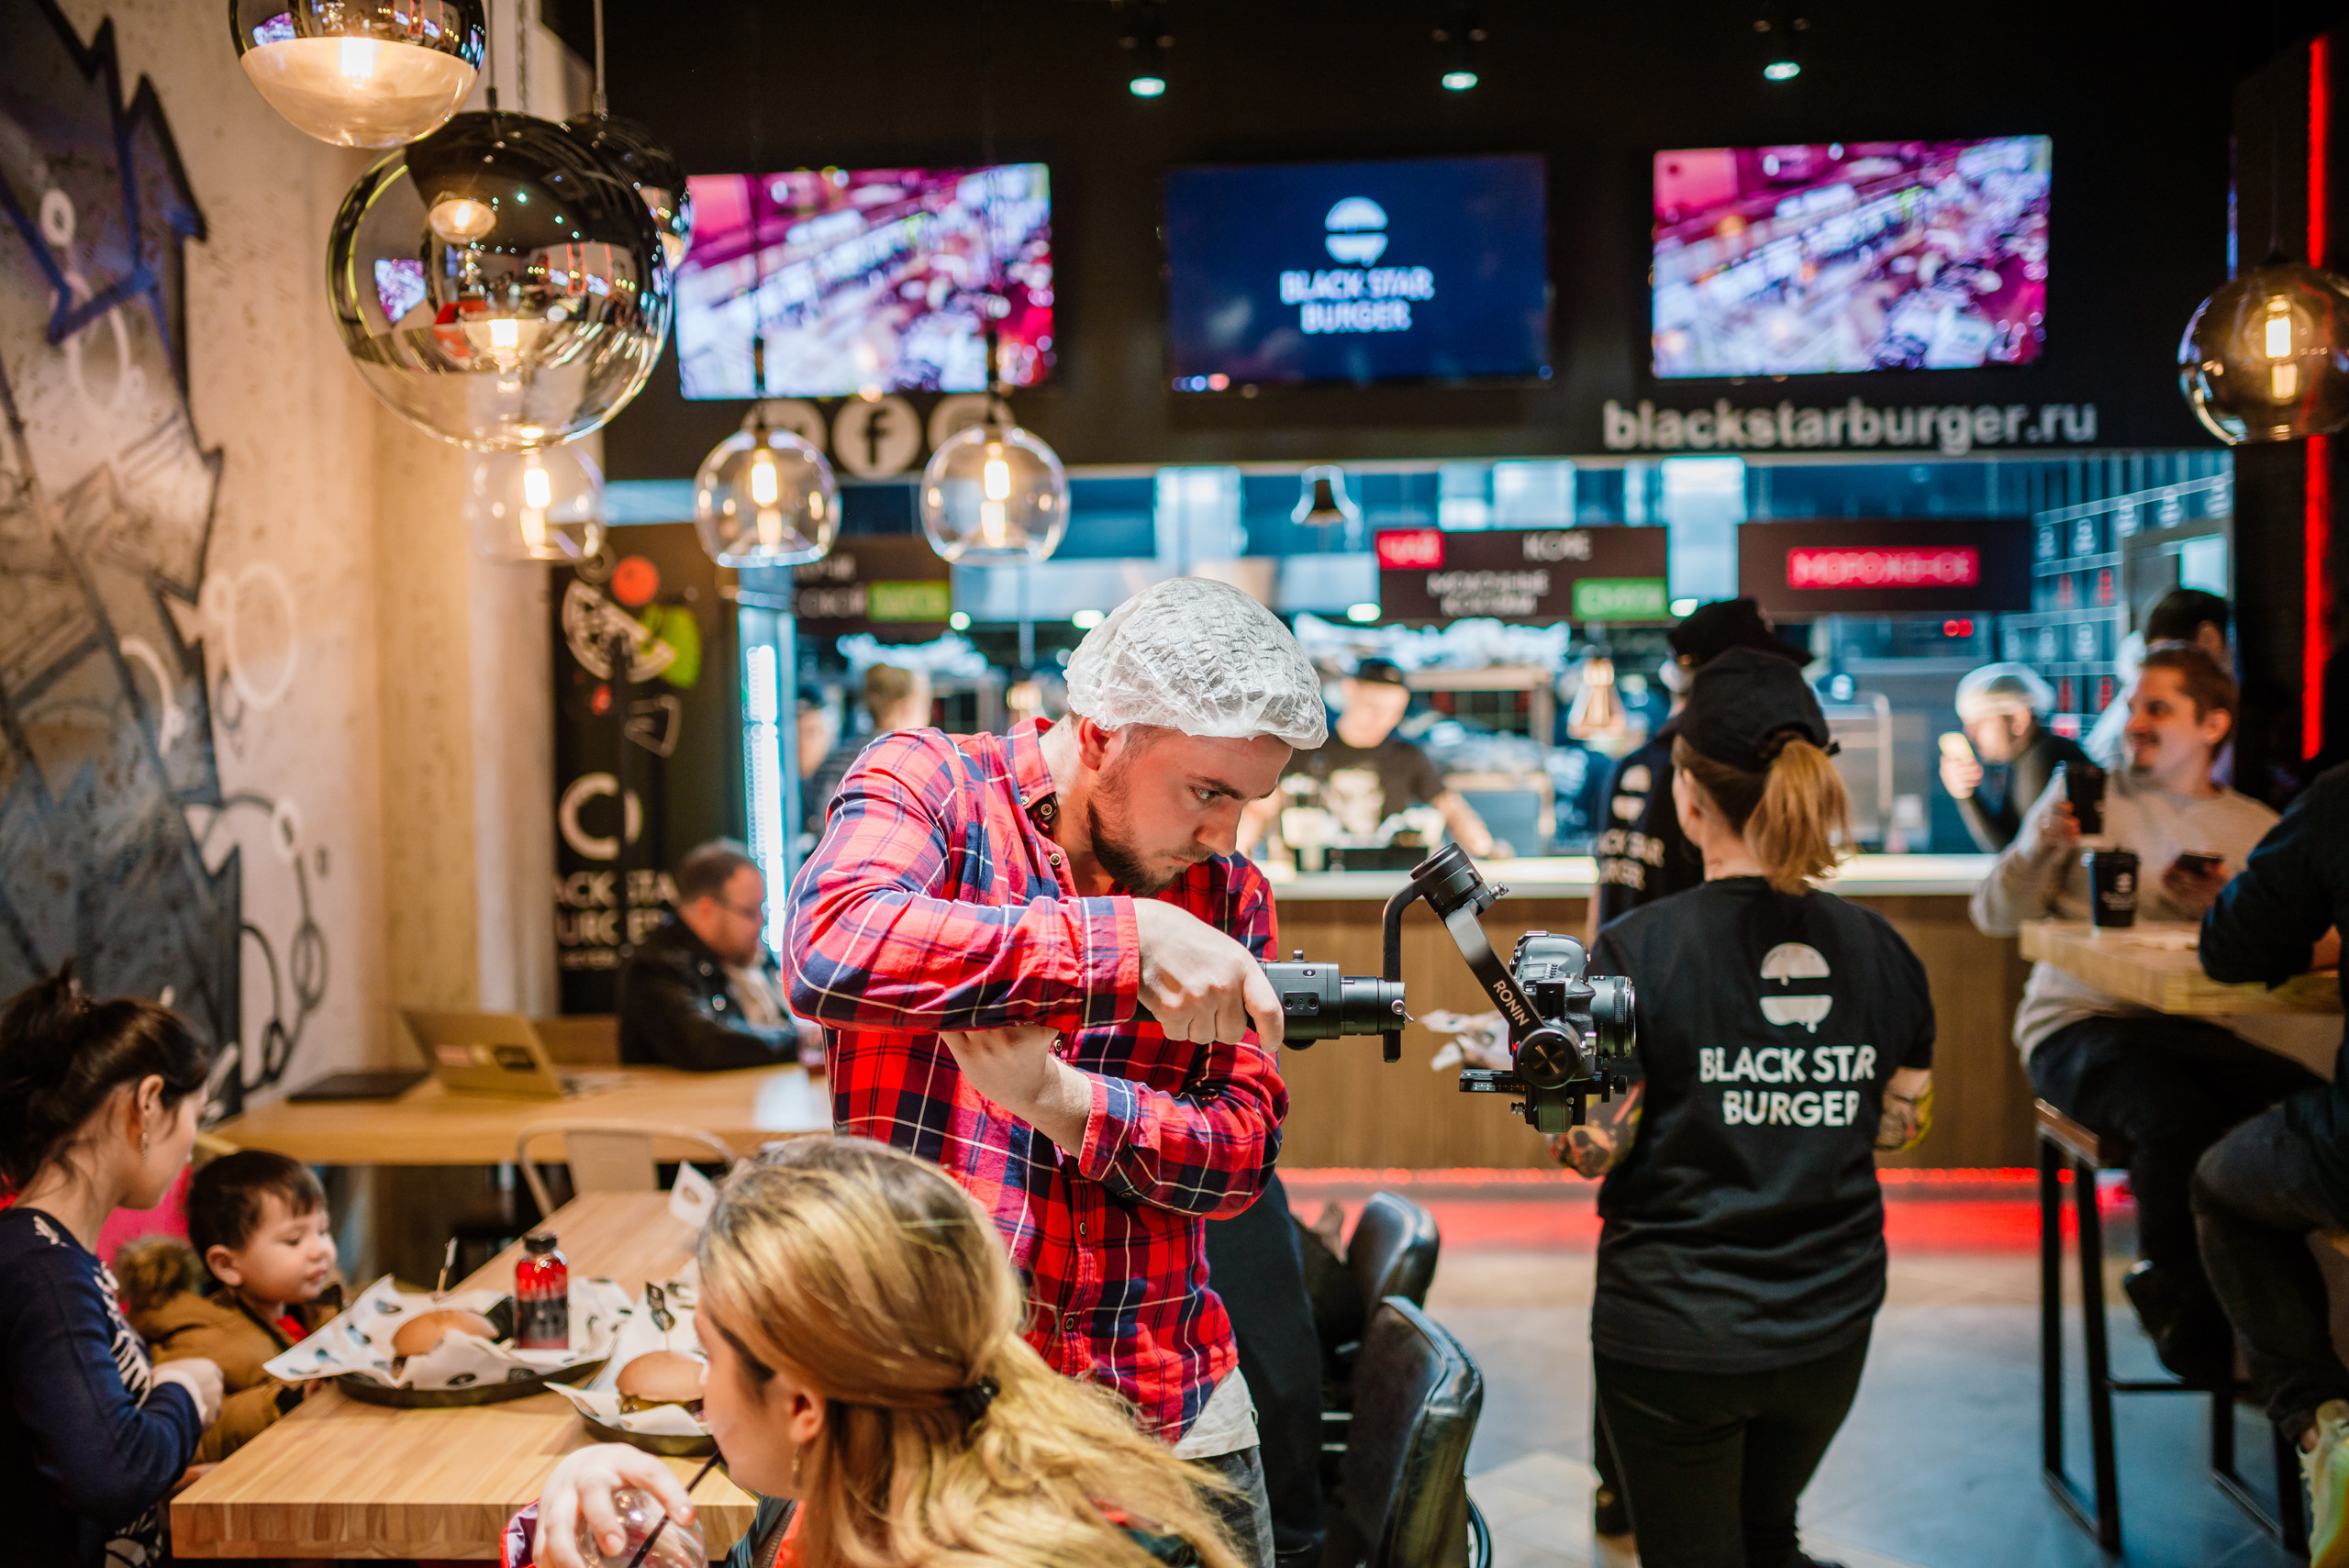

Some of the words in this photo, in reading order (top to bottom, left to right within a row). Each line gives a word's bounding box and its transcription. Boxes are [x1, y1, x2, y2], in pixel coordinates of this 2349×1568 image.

[1281, 270, 1366, 304] BLACK
[1367, 266, 1434, 300] STAR
[1301, 299, 1412, 333] BURGER
[1603, 398, 2098, 455] blackstarburger.ru
[1492, 979, 1530, 1027] RONIN
[1699, 1046, 1807, 1084] BLACK
